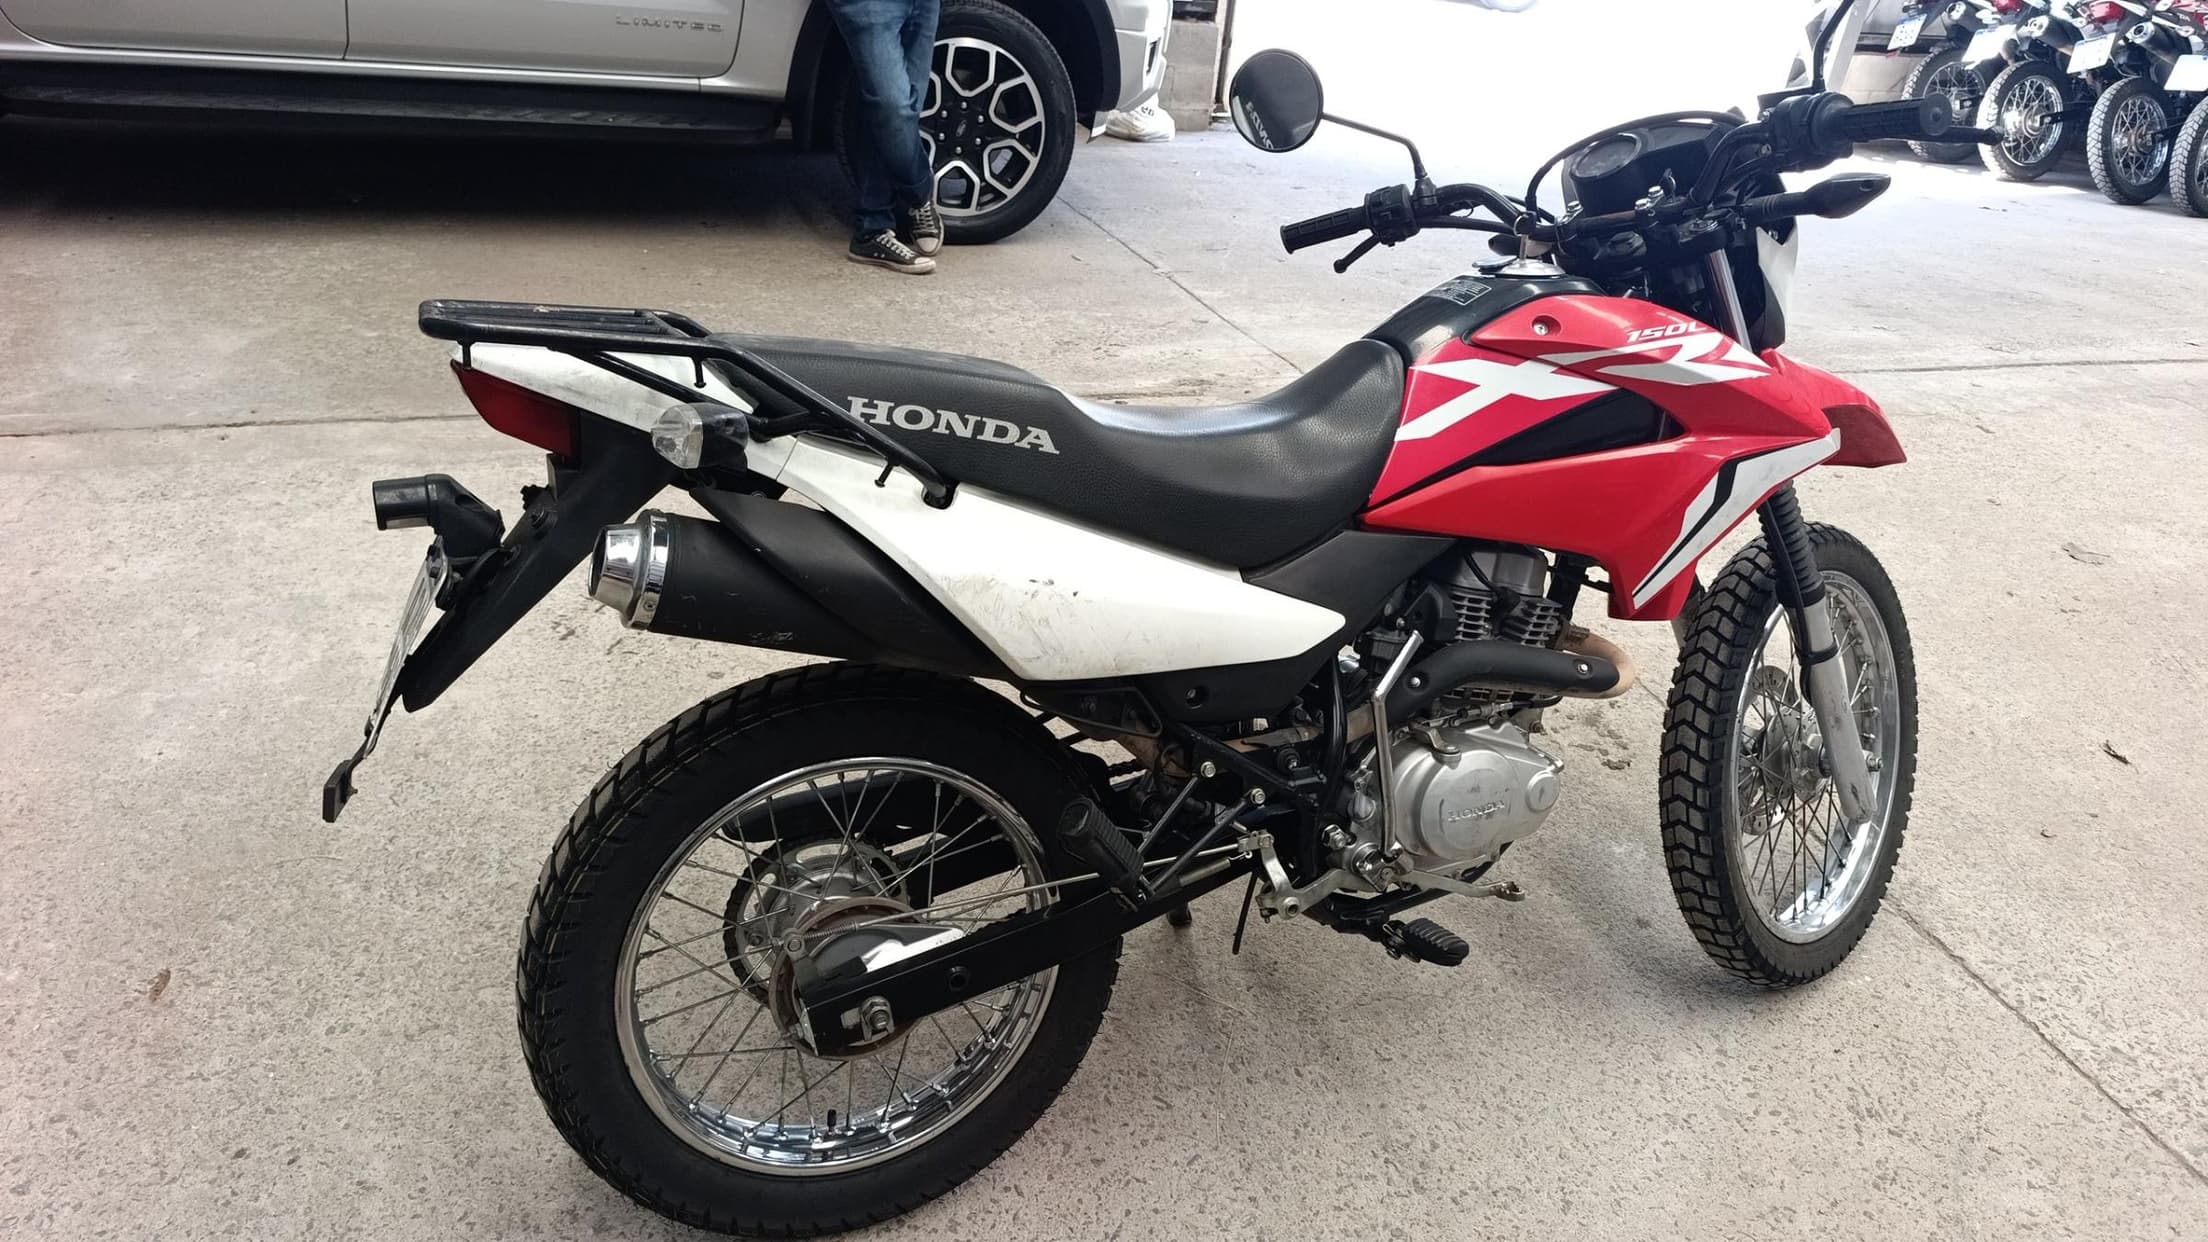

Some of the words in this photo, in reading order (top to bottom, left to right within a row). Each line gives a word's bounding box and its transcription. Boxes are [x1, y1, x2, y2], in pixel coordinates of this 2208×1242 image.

[615, 15, 722, 33] LIMITED
[1625, 321, 1708, 343] 150L
[847, 396, 1060, 455] HONDA
[1447, 800, 1505, 821] HONDA
